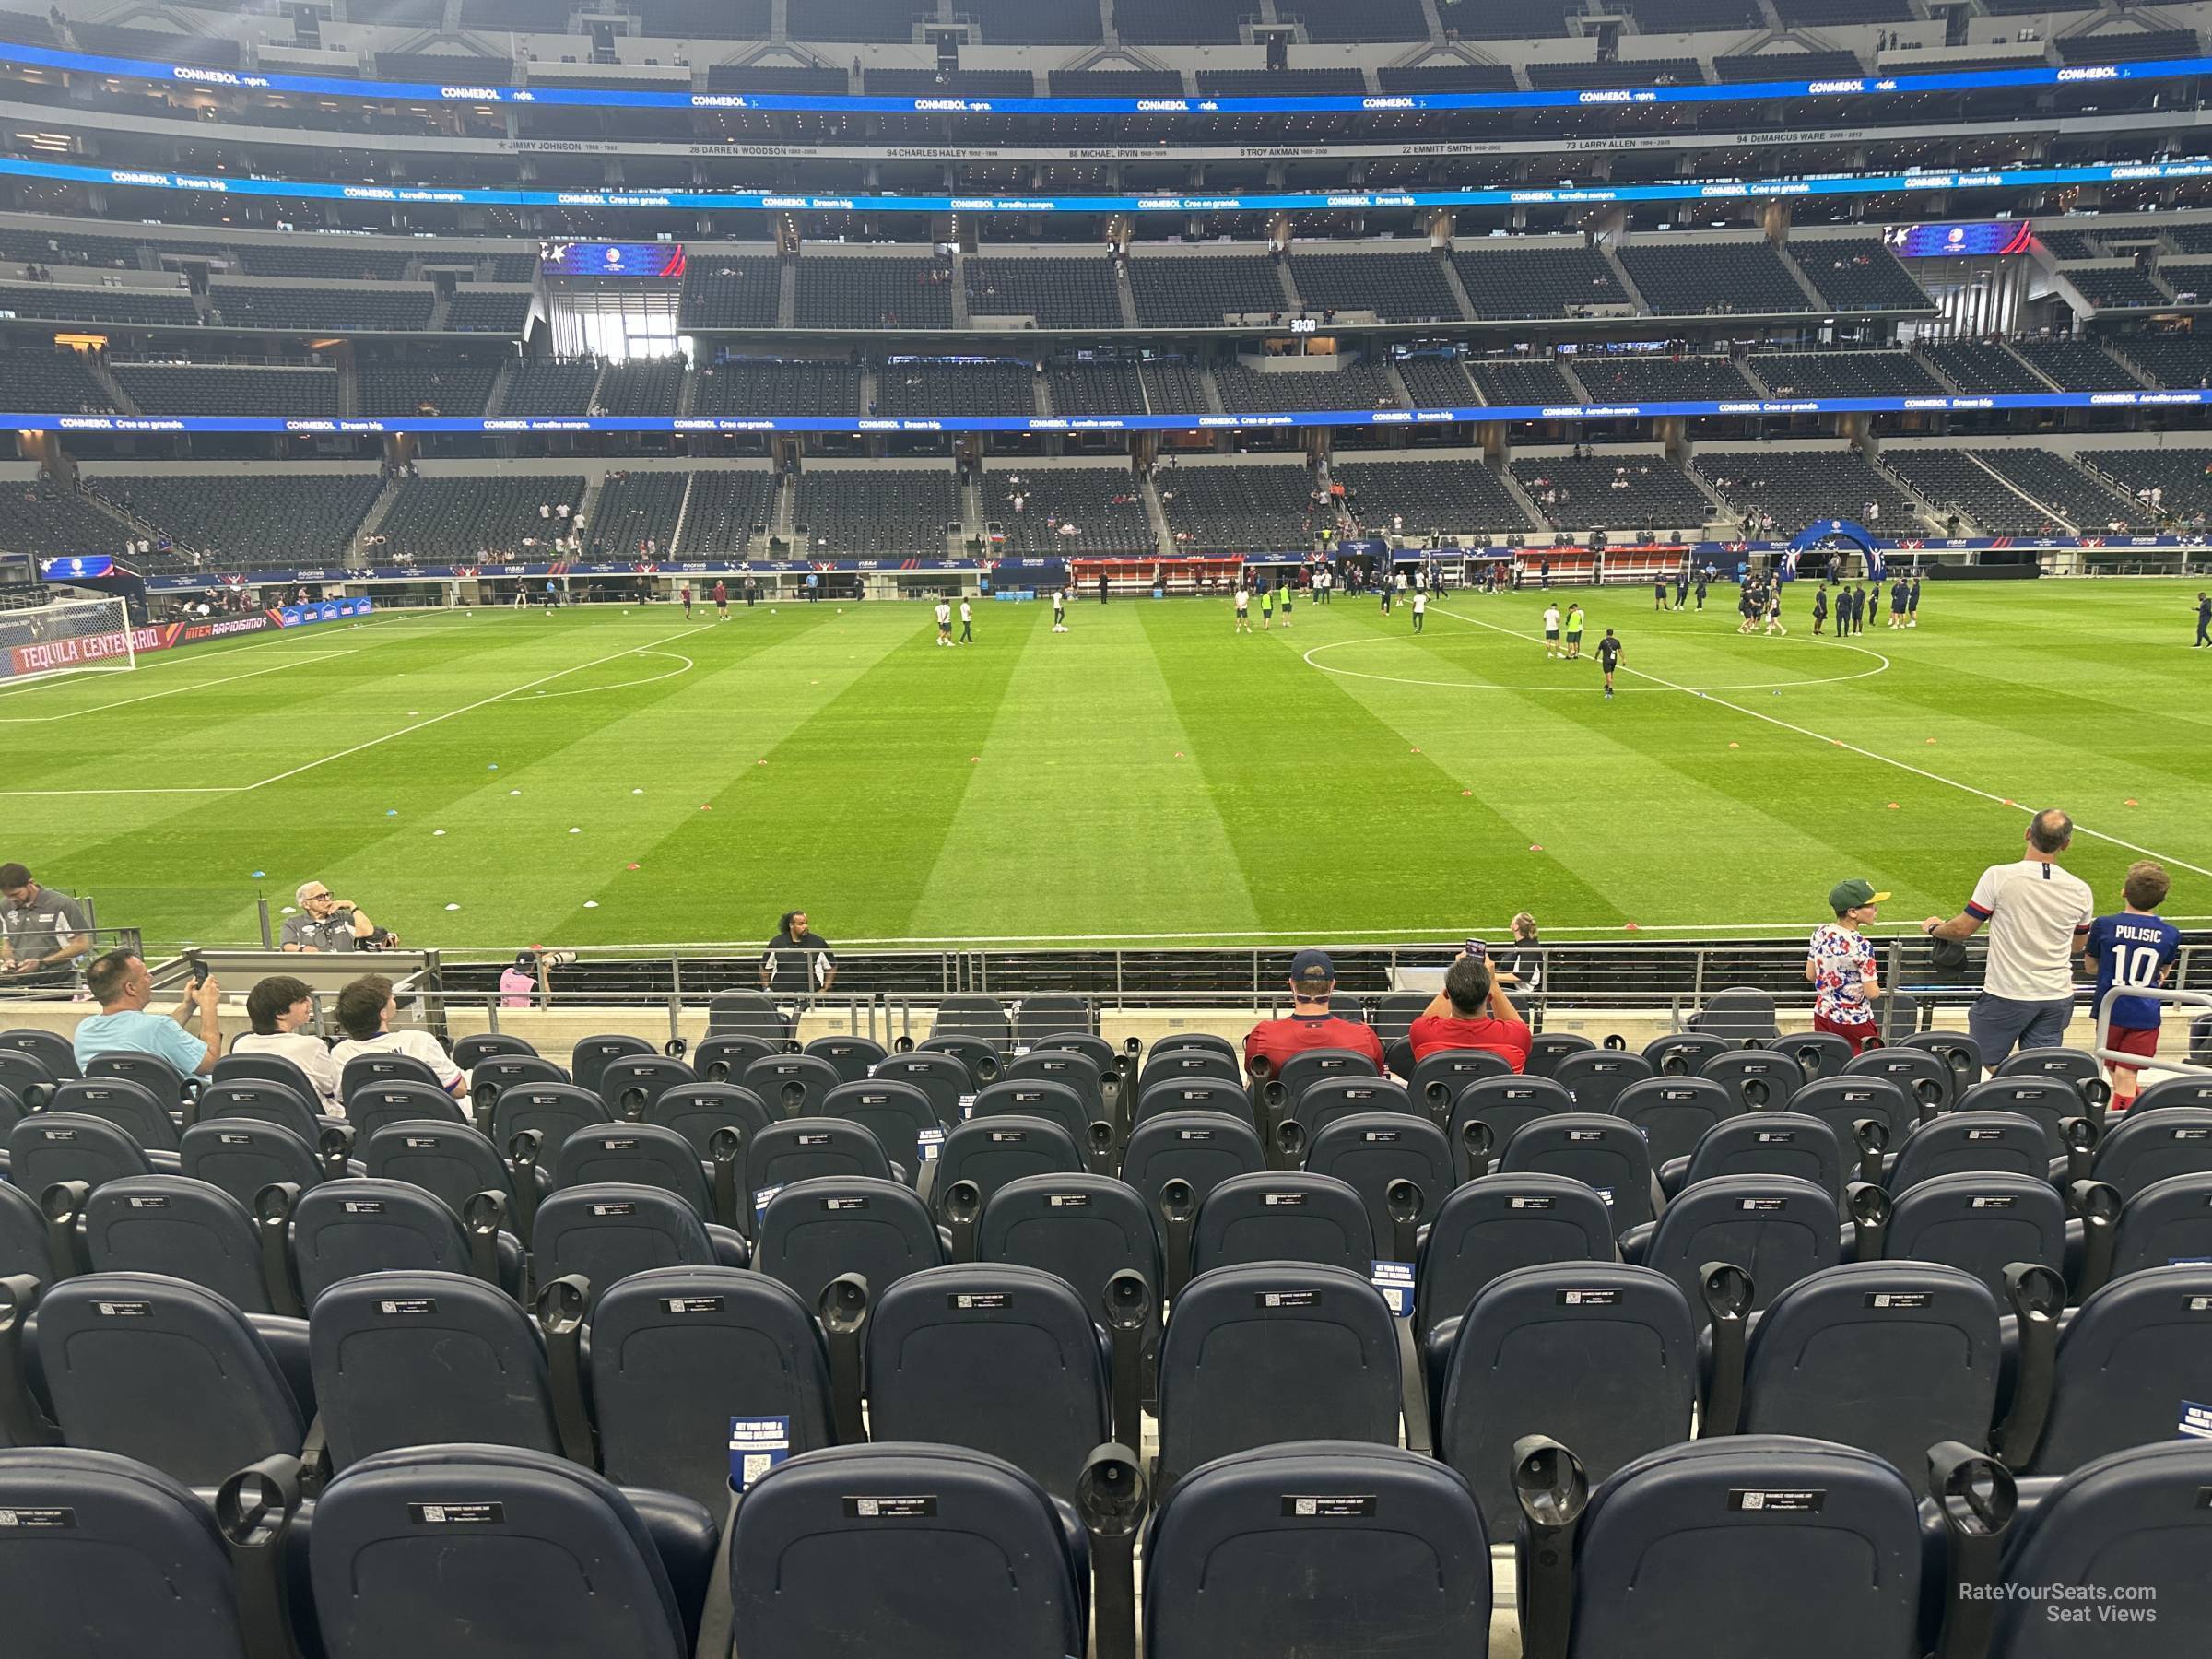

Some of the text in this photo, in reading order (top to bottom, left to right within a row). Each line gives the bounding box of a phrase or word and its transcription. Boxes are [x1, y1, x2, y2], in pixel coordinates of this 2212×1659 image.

[174, 66, 241, 84] CONMEBOL
[2057, 67, 2117, 80] CONMEBOL
[1809, 81, 1864, 93] CONMEBOL
[441, 88, 500, 99] CONMEBOL
[1580, 91, 1631, 101] CONMEBOL
[692, 96, 747, 106] CONMEBOL
[915, 100, 968, 110] CONMEBOL
[1137, 101, 1188, 110] CONMEBOL
[1363, 98, 1414, 107] CONMEBOL
[2112, 167, 2161, 177] CONMEBOL
[112, 171, 170, 184] CONMEBOL
[1905, 177, 1952, 187] CONMEBOL
[344, 187, 395, 198] CONMEBOL
[1702, 186, 1747, 194] CONMEBOL
[559, 194, 606, 204] CONMEBOL
[763, 198, 807, 206] CONMEBOL
[1328, 197, 1370, 206] CONMEBOL
[1512, 193, 1554, 202] CONMEBOL
[1291, 319, 1315, 332] 30:00
[1905, 399, 1947, 407] CONMEBOL
[2091, 394, 2136, 404] CONMEBOL
[1543, 408, 1583, 418] CONMEBOL
[60, 418, 113, 428] CONMEBOL
[287, 421, 335, 429] CONMEBOL
[20, 641, 78, 668] TEQUILA
[2116, 924, 2162, 943] PULISIC
[2112, 944, 2159, 987] 10
